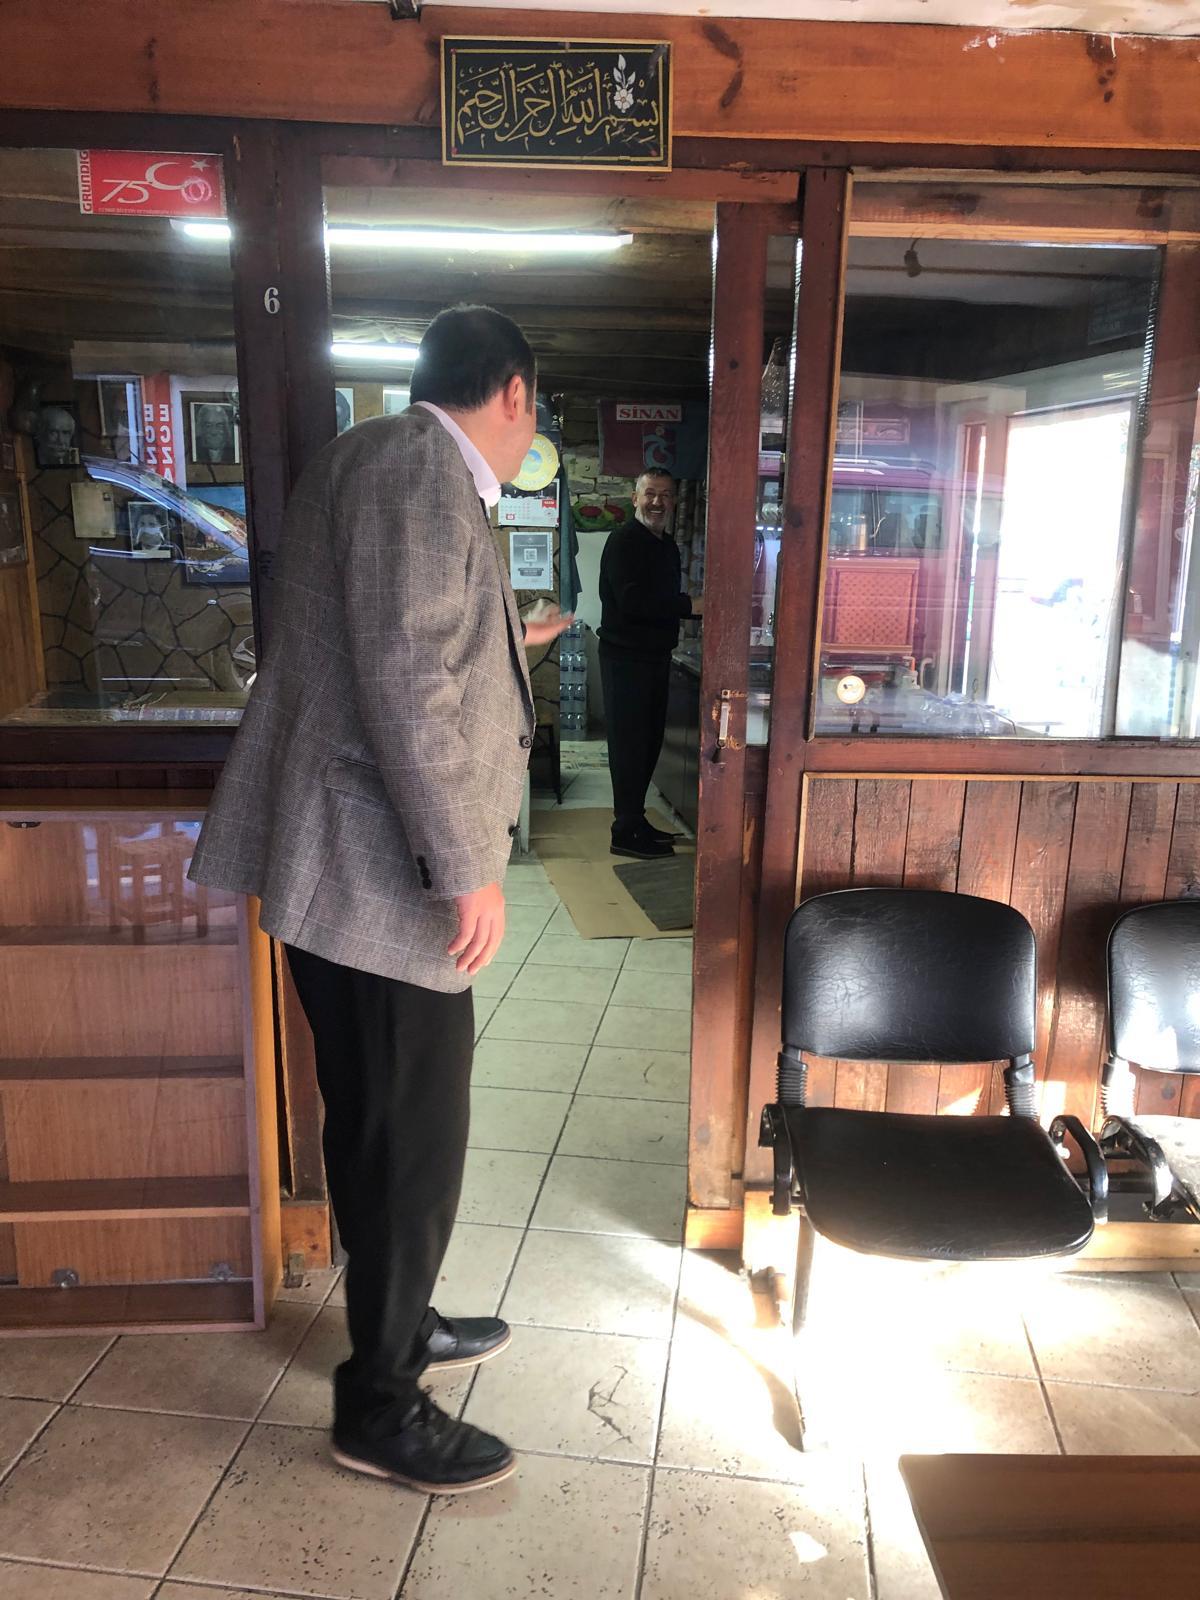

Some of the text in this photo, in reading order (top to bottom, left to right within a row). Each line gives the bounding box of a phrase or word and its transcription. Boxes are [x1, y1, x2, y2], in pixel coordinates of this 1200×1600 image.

[79, 150, 93, 213] GRUNDIG
[264, 287, 280, 314] 6
[619, 405, 679, 419] SİNAN
